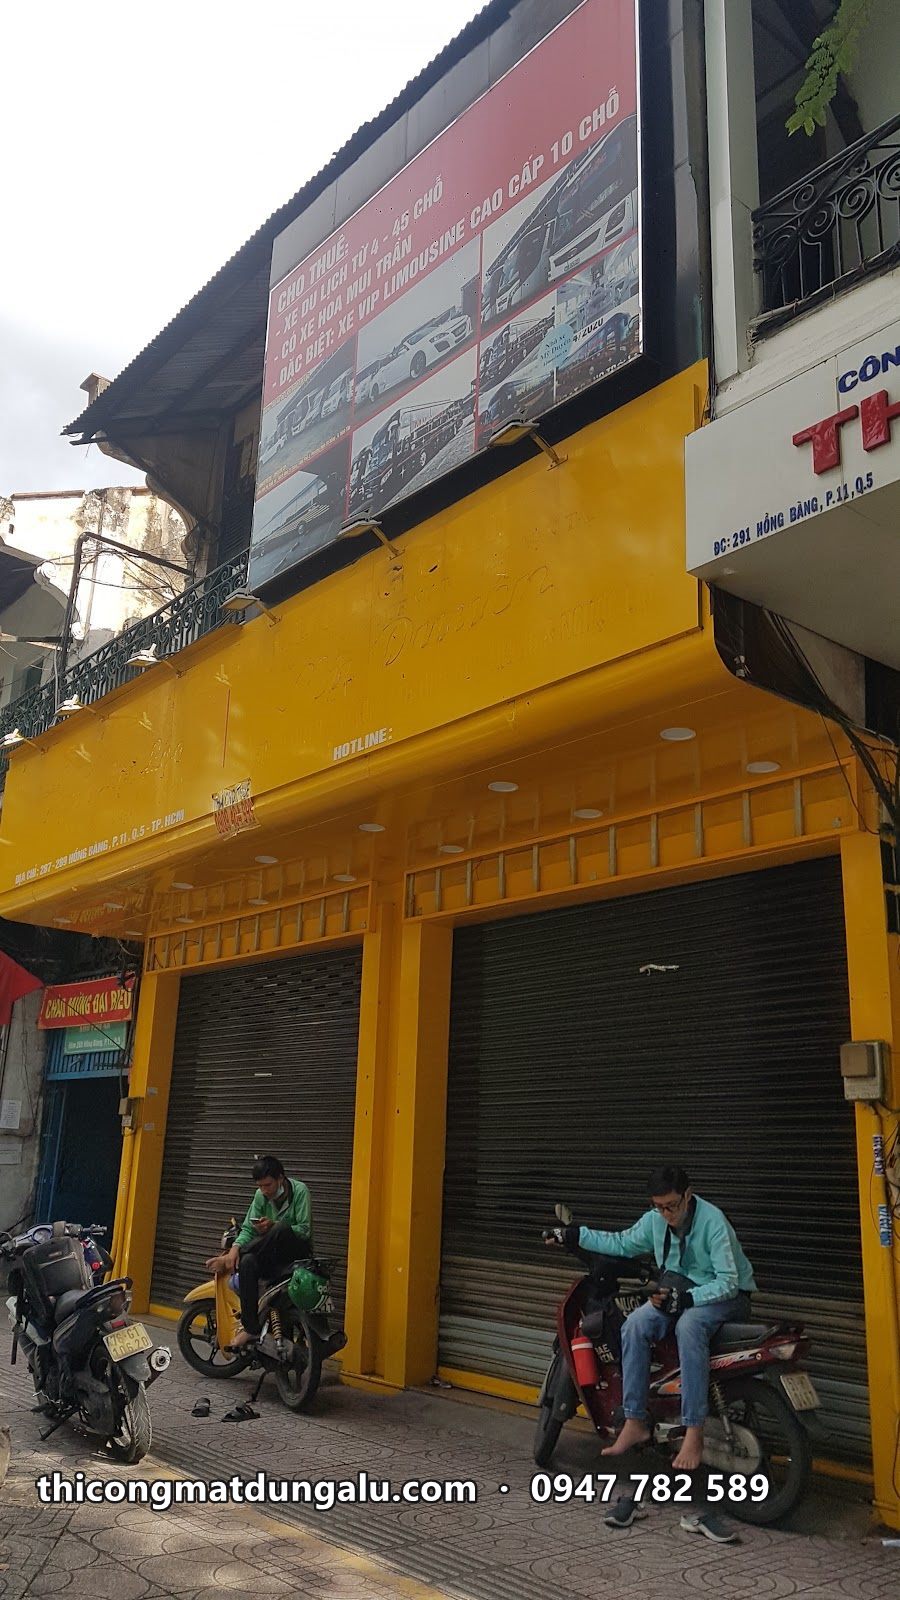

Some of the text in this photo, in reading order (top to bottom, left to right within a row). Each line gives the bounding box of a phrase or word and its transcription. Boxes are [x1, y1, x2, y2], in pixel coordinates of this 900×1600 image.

[277, 234, 349, 313] CHO THUÊ:
[280, 353, 303, 386] ĐẶC
[305, 328, 334, 365] BIỆT:
[338, 310, 355, 338] XE
[358, 289, 379, 320] VIP
[383, 217, 465, 300] LIMOUSINE
[470, 188, 503, 229] CAO
[508, 154, 544, 198] CẤP
[550, 131, 573, 164] 10
[579, 85, 619, 141] CHỖ
[284, 308, 298, 333] XE
[301, 292, 317, 317] DU
[320, 264, 348, 299] LỊCH
[352, 241, 369, 274] TỪ
[371, 238, 378, 255] 4
[392, 210, 409, 236] 45
[413, 173, 443, 219] CHỖ
[281, 330, 297, 359] CÓ
[300, 318, 315, 344] XE
[318, 295, 342, 328] HOA
[346, 268, 372, 304] MUI
[333, 727, 393, 761] HOTLINE:
